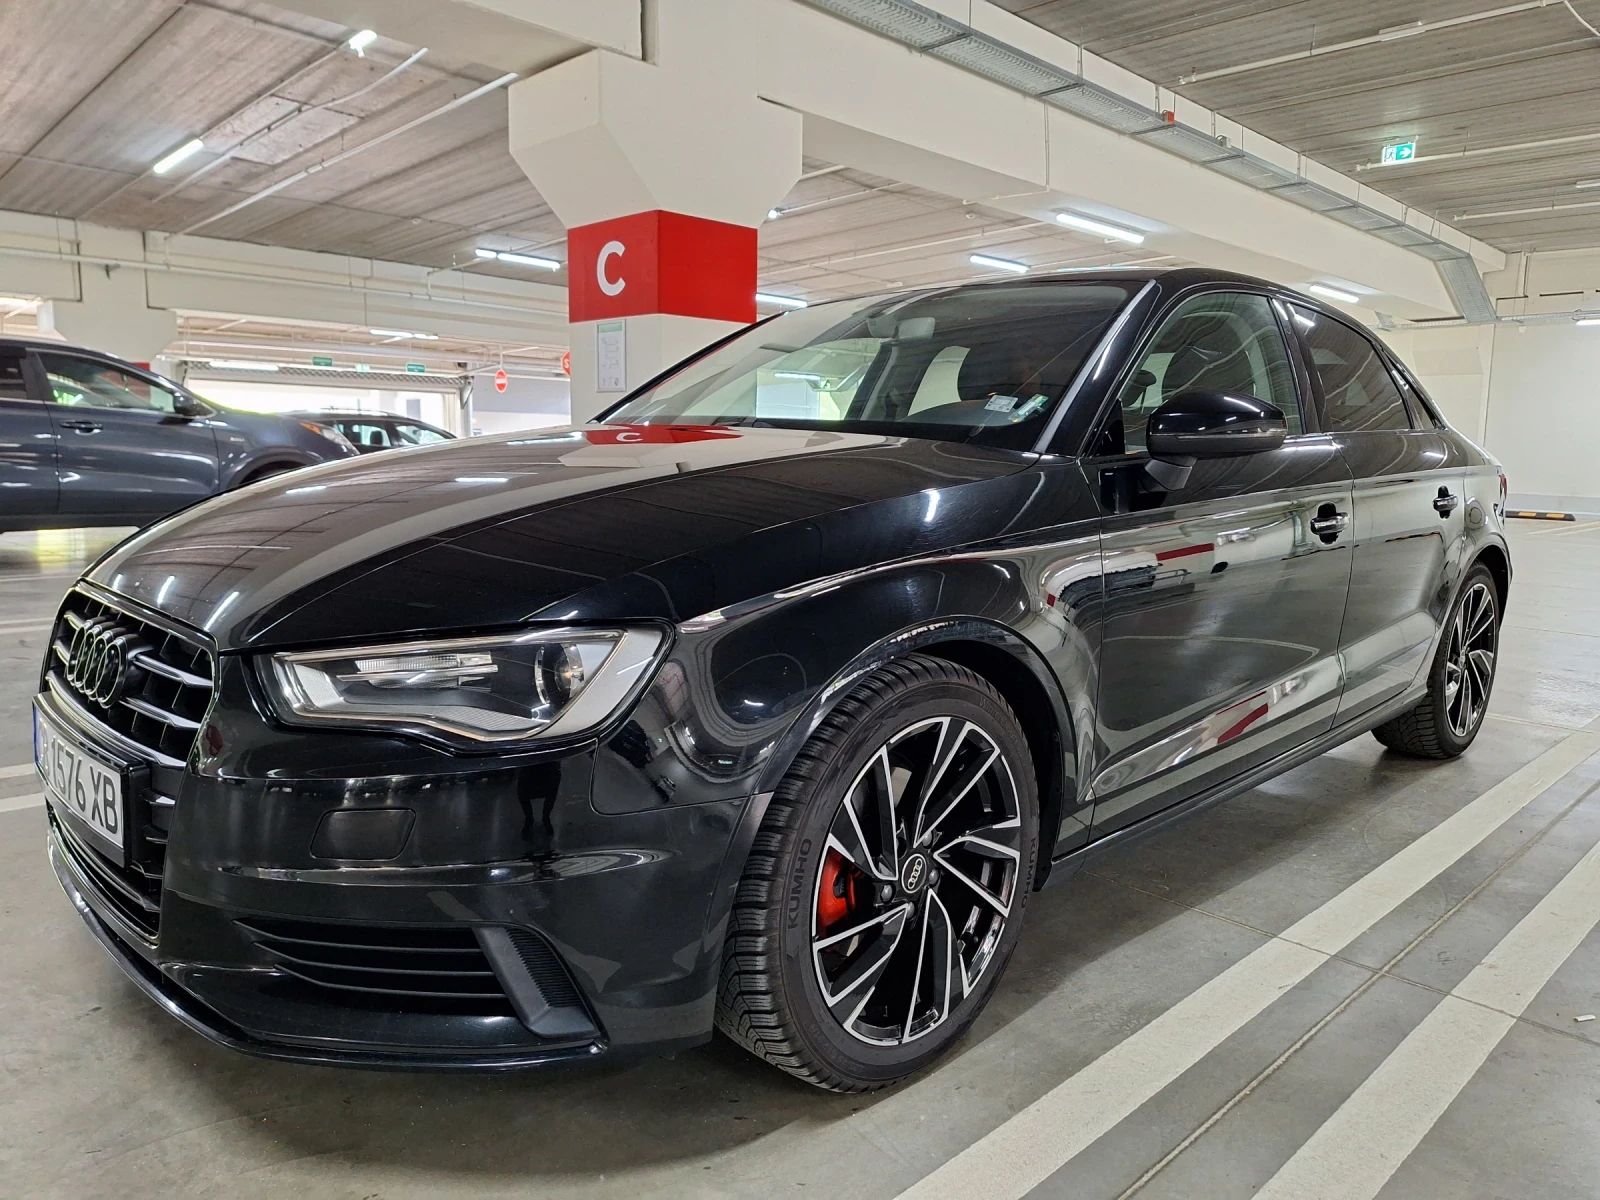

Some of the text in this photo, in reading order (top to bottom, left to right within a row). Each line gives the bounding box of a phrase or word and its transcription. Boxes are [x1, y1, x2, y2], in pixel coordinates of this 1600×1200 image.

[596, 240, 626, 297] C
[50, 734, 87, 813] 1576
[89, 765, 118, 835] XB
[787, 838, 812, 930] KUMHO
[1021, 837, 1037, 908] KUMHO
